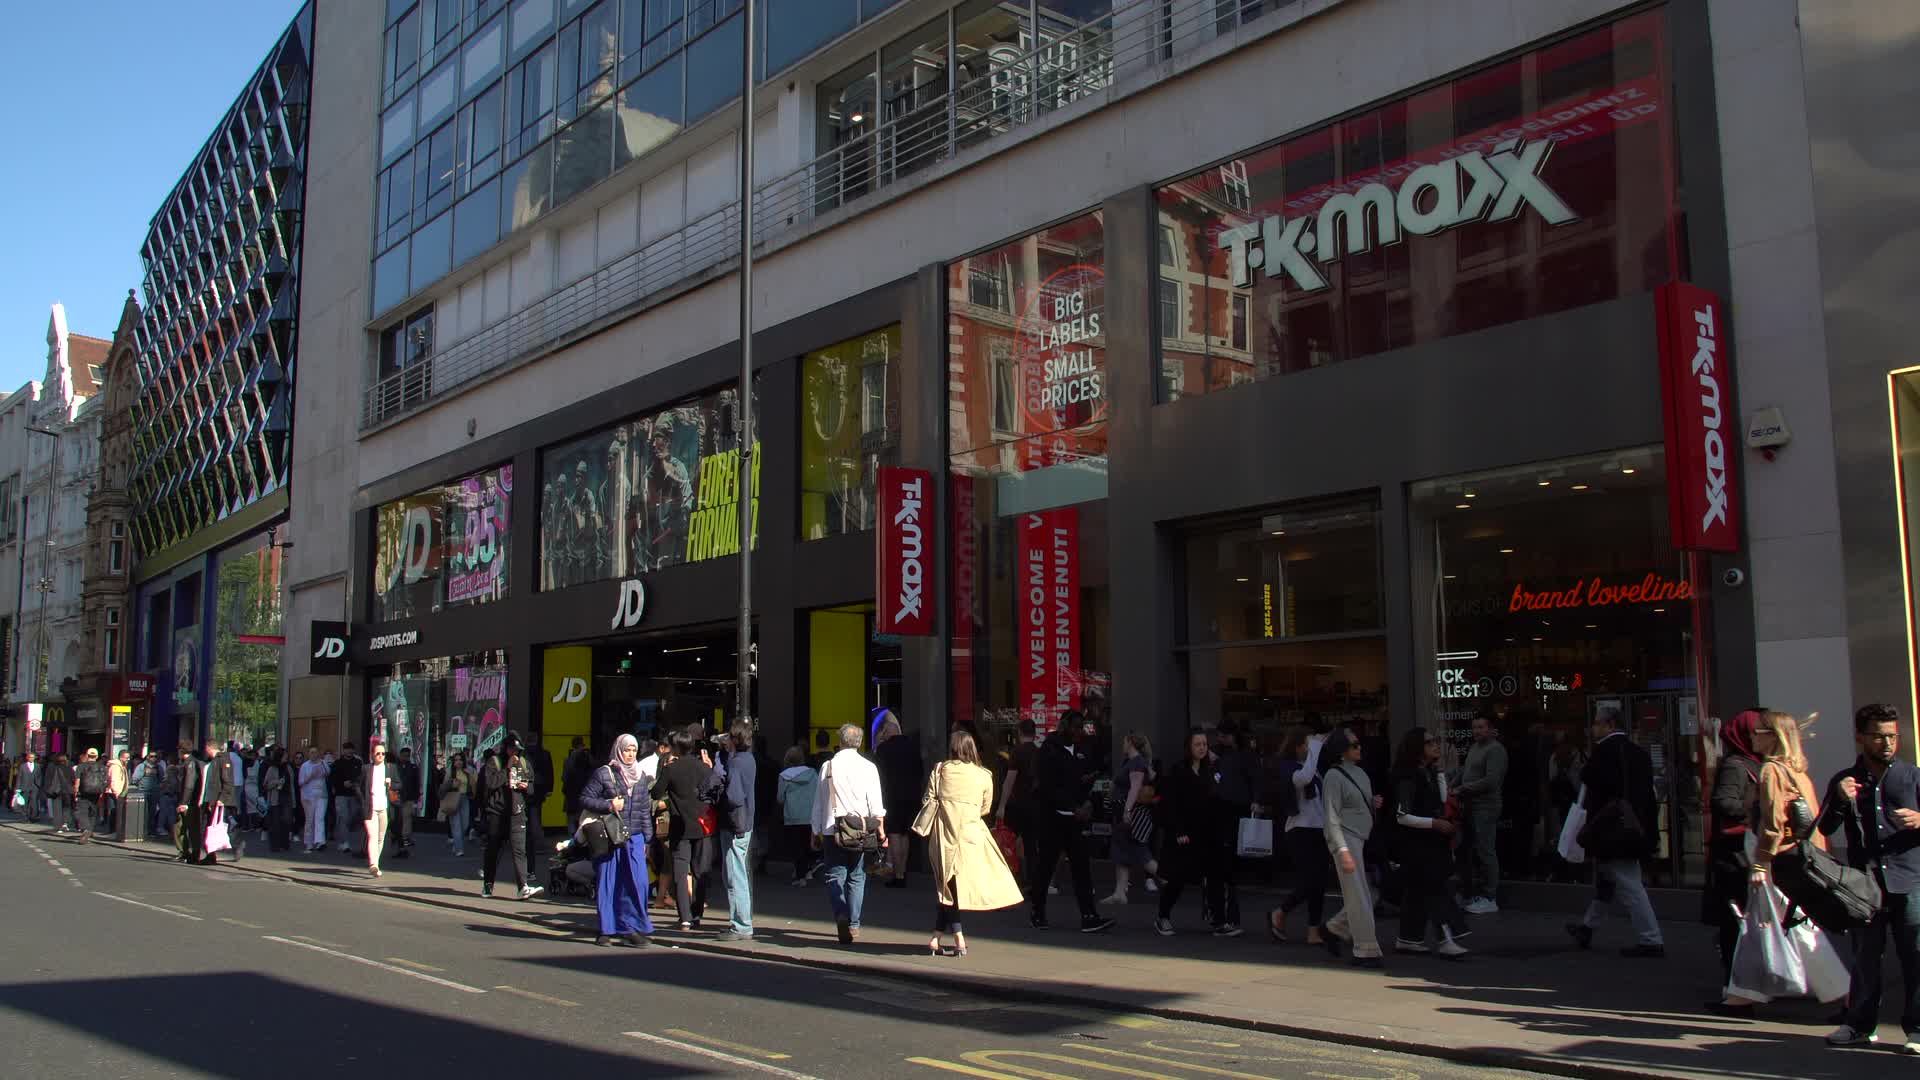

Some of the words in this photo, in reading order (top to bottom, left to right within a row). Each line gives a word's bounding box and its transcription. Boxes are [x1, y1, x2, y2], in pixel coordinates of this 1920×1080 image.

[1054, 291, 1083, 321] BIG
[1040, 313, 1100, 352] LABELS
[1044, 349, 1097, 383] SMALL
[1041, 375, 1101, 410] PRICES
[686, 498, 759, 563] FORWAD
[611, 579, 646, 630] JD
[1055, 528, 1071, 667] BENVENUTI
[1508, 578, 1585, 613] brand
[1587, 569, 1691, 608] loveline
[1030, 548, 1045, 679] WELCOME
[314, 637, 345, 659] JD
[369, 630, 417, 651] JDSPORTS.COM
[129, 680, 148, 689] MUJI
[552, 676, 587, 703] JD
[1438, 683, 1480, 699] LLECT
[1535, 675, 1541, 690] 3
